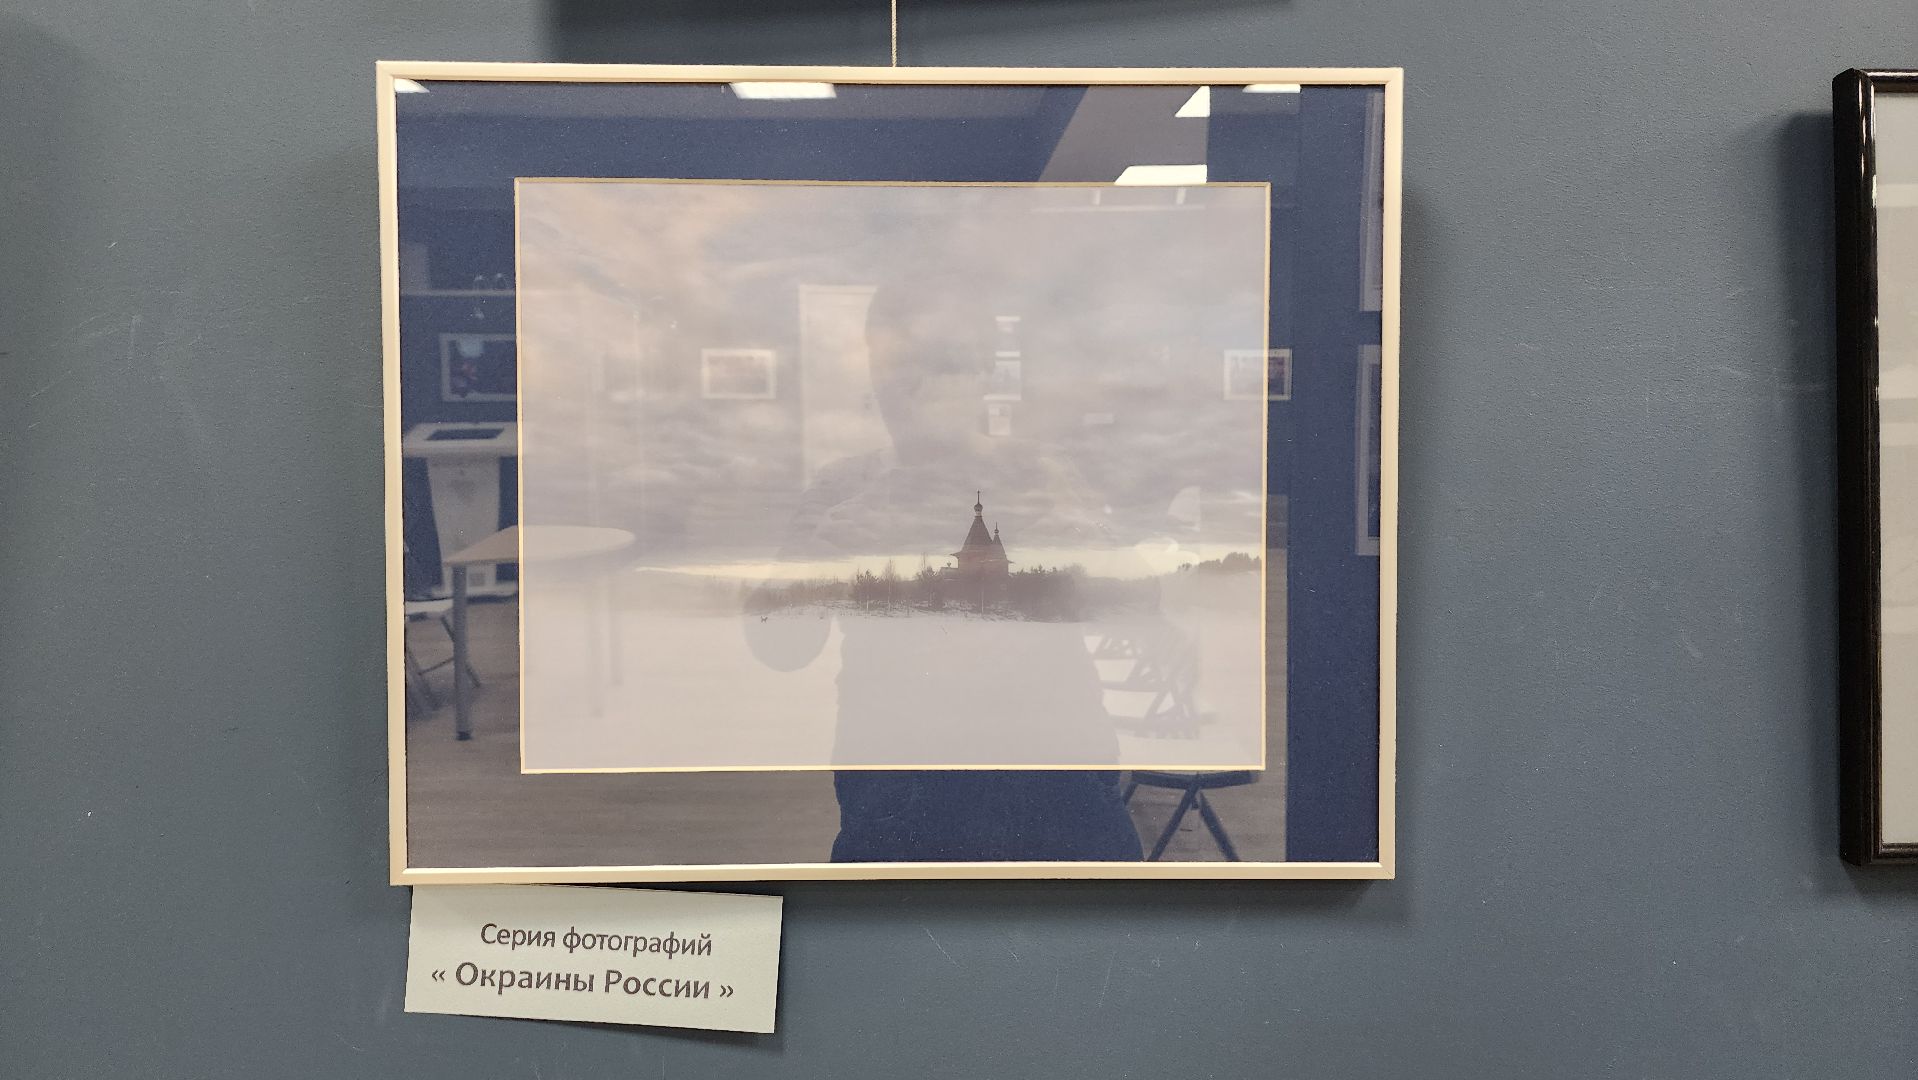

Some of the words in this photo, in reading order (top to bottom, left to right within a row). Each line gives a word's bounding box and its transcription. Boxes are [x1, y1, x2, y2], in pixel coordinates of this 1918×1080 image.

[480, 923, 556, 951] Серия
[562, 926, 712, 960] фотографий
[455, 961, 595, 996] Окраины
[604, 969, 711, 999] России
